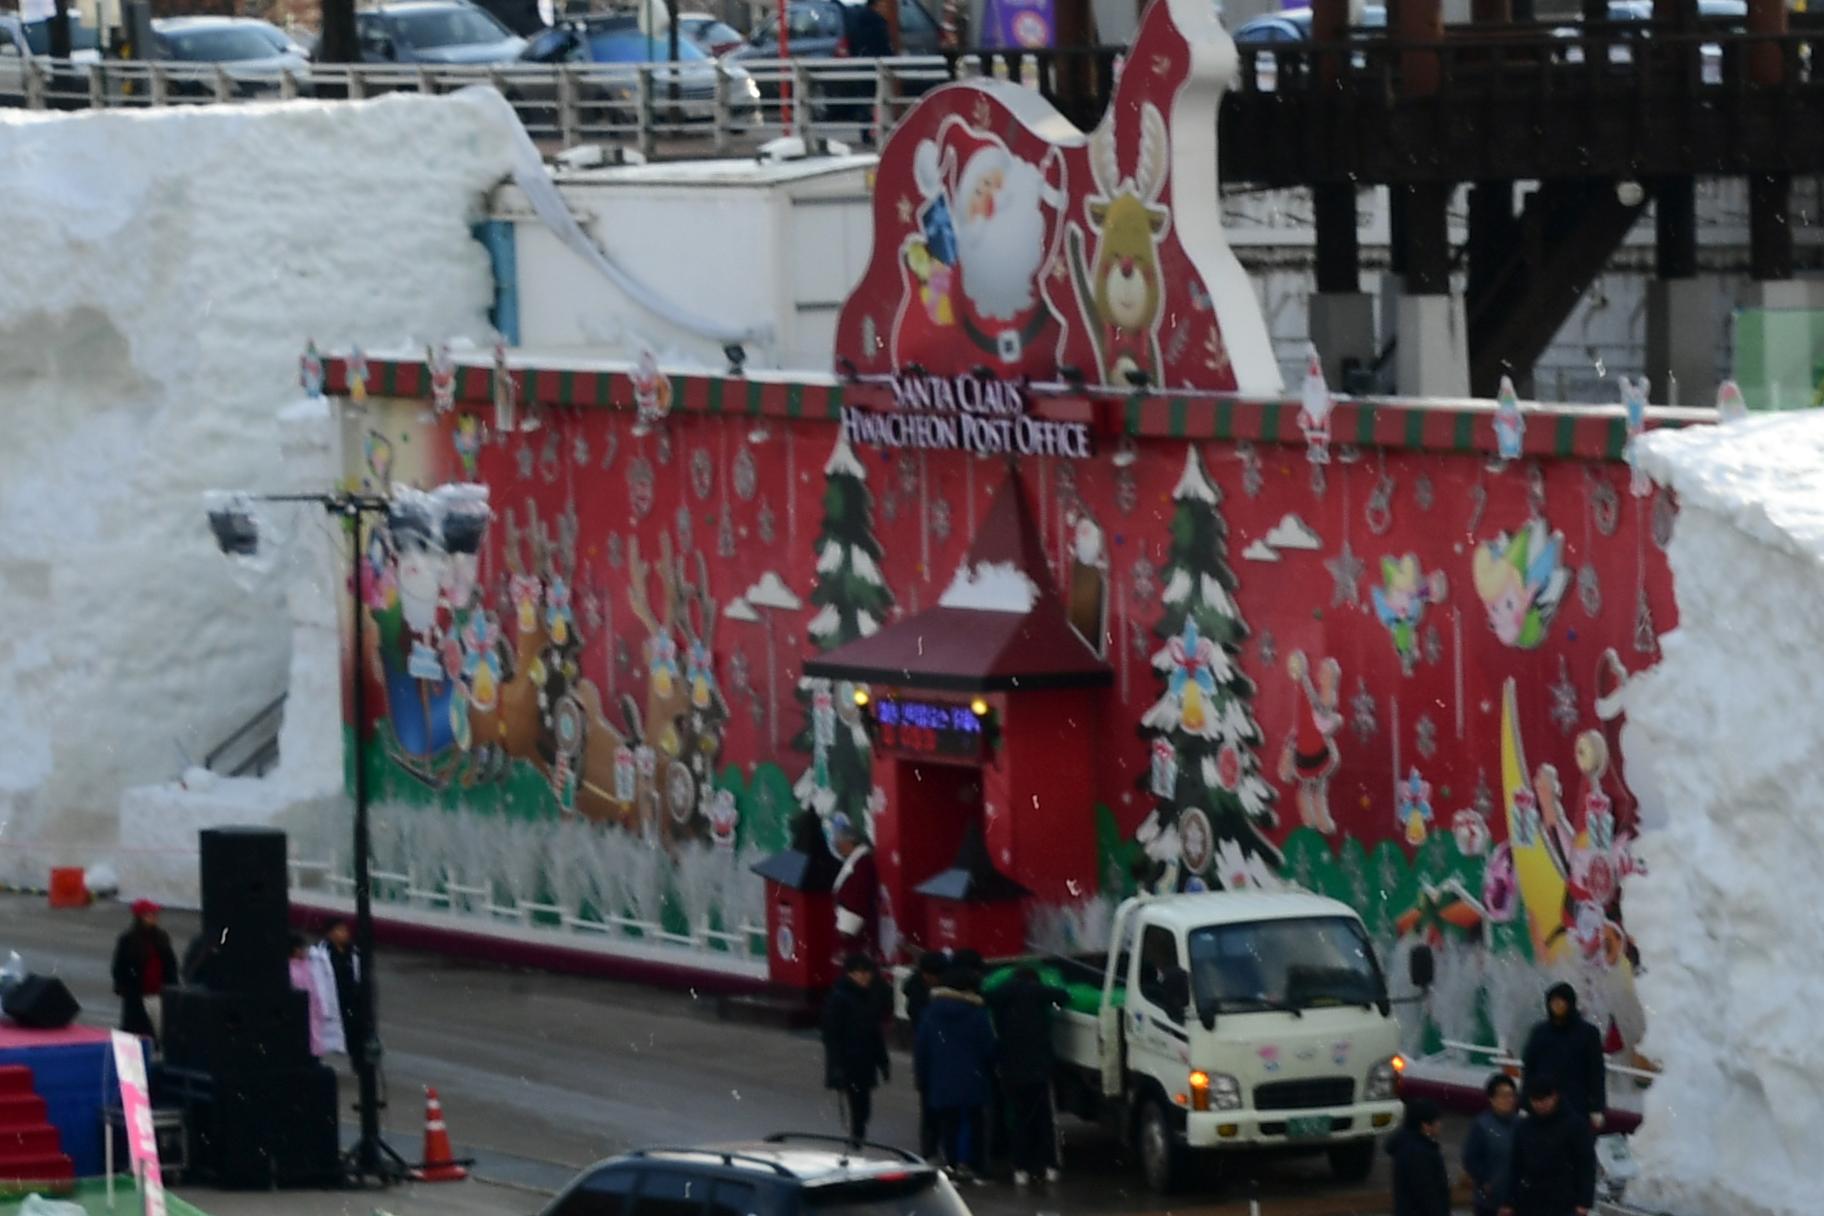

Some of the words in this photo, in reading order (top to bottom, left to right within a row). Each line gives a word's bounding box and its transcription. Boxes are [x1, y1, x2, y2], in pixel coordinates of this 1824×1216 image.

[894, 375, 957, 411] SANTA
[841, 407, 957, 447] HWACHEON
[960, 414, 1015, 451] POST
[1015, 416, 1090, 458] OFFICE
